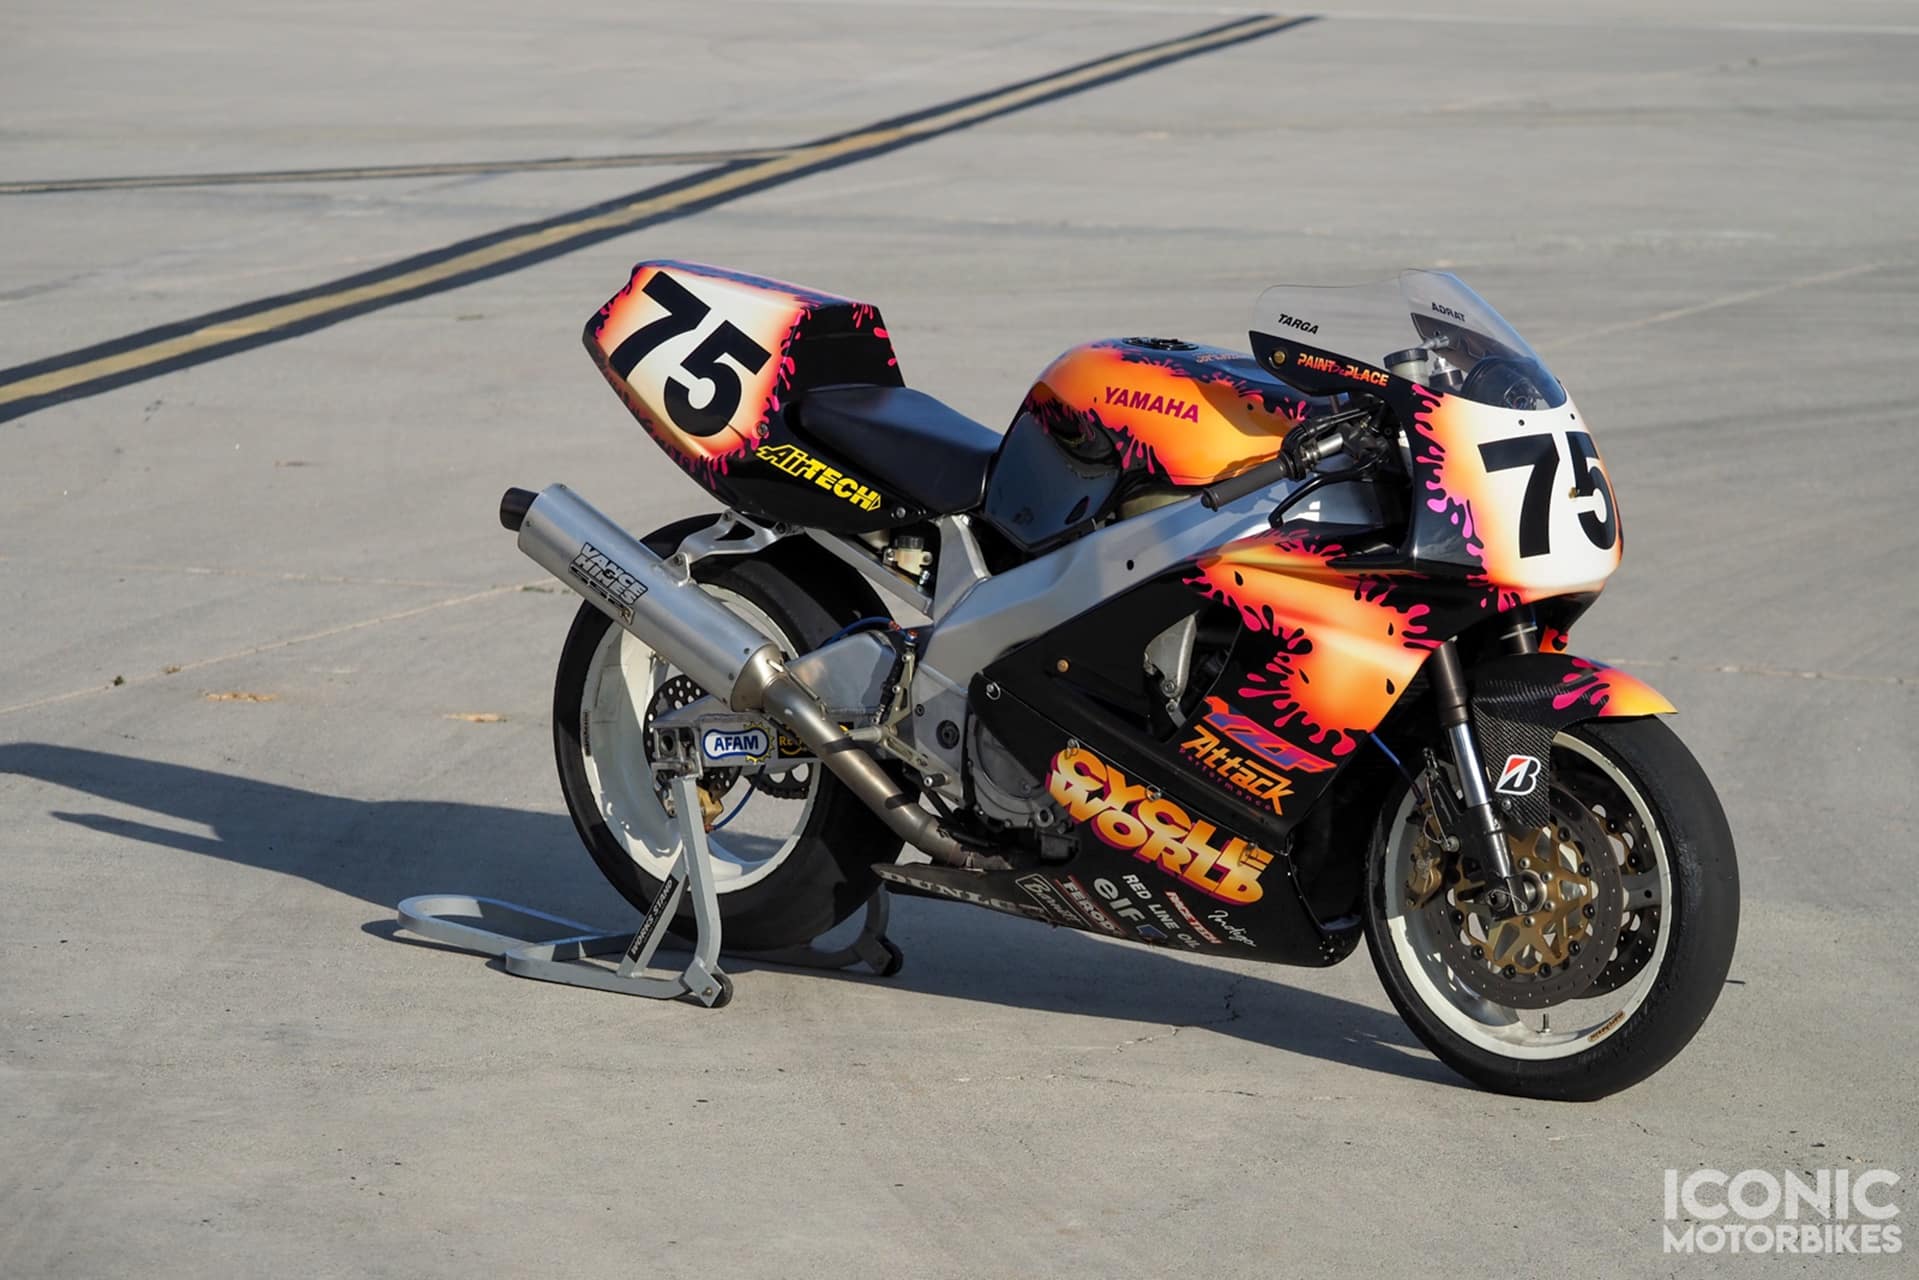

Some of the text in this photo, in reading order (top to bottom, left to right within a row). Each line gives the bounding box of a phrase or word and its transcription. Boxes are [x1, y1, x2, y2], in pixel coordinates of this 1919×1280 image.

[1278, 313, 1319, 335] TARGA
[609, 270, 772, 438] 75
[1297, 353, 1336, 373] PAINT
[1344, 364, 1389, 387] PLACE
[1105, 386, 1199, 423] YAMAHA
[1477, 431, 1616, 559] 75
[573, 553, 638, 605] HINES
[580, 541, 649, 598] VANCE
[714, 735, 759, 751] AFAM
[1180, 724, 1295, 816] Attack
[1046, 769, 1264, 906] WORLD
[1050, 747, 1274, 873] CYCLE
[630, 914, 654, 955] WORKS
[652, 879, 673, 916] STAND
[1122, 874, 1152, 900] RED
[1149, 903, 1180, 930] LINE
